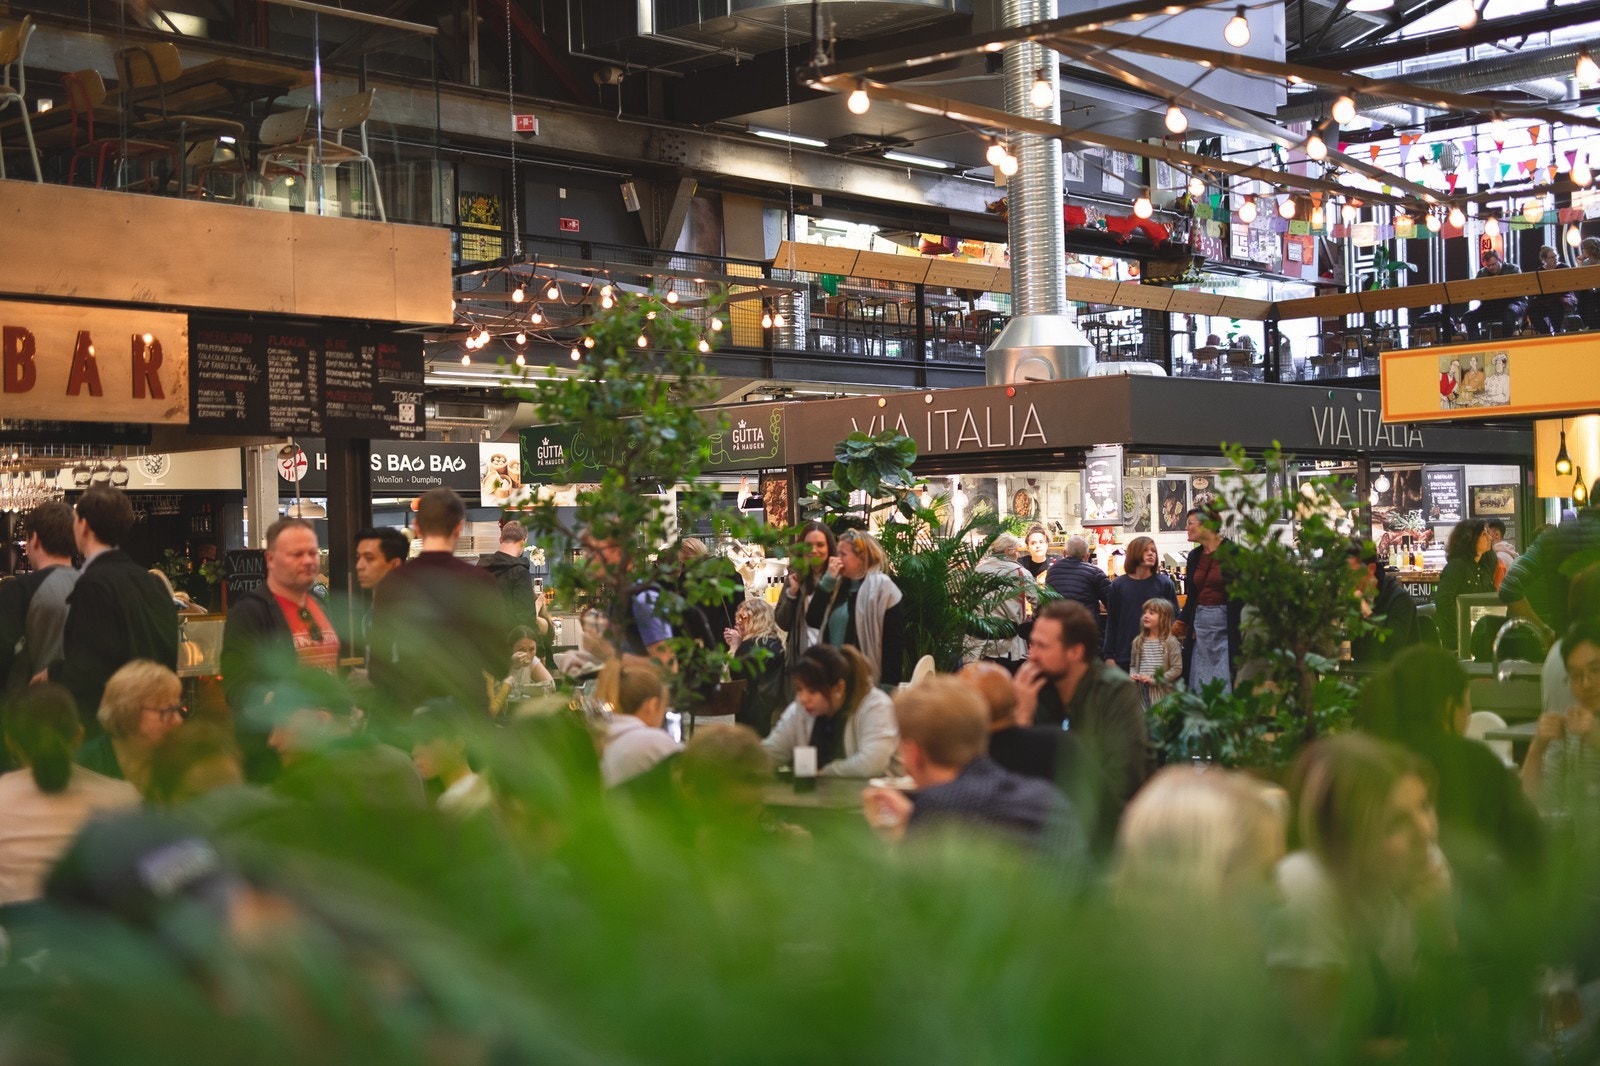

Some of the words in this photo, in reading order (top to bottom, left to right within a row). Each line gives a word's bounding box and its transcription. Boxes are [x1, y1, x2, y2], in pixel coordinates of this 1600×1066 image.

[3, 326, 166, 400] BAR
[390, 425, 424, 433] MATHALLEN
[925, 402, 1047, 452] ITALIA
[1311, 404, 1353, 446] VIA
[732, 427, 765, 443] GUTTA
[537, 444, 564, 459] GUTTA
[741, 442, 765, 450] HAUGEN
[545, 458, 565, 466] HAUGEN
[377, 475, 403, 483] WonTon
[411, 475, 442, 485] Dumpling
[1403, 583, 1431, 597] MENU
